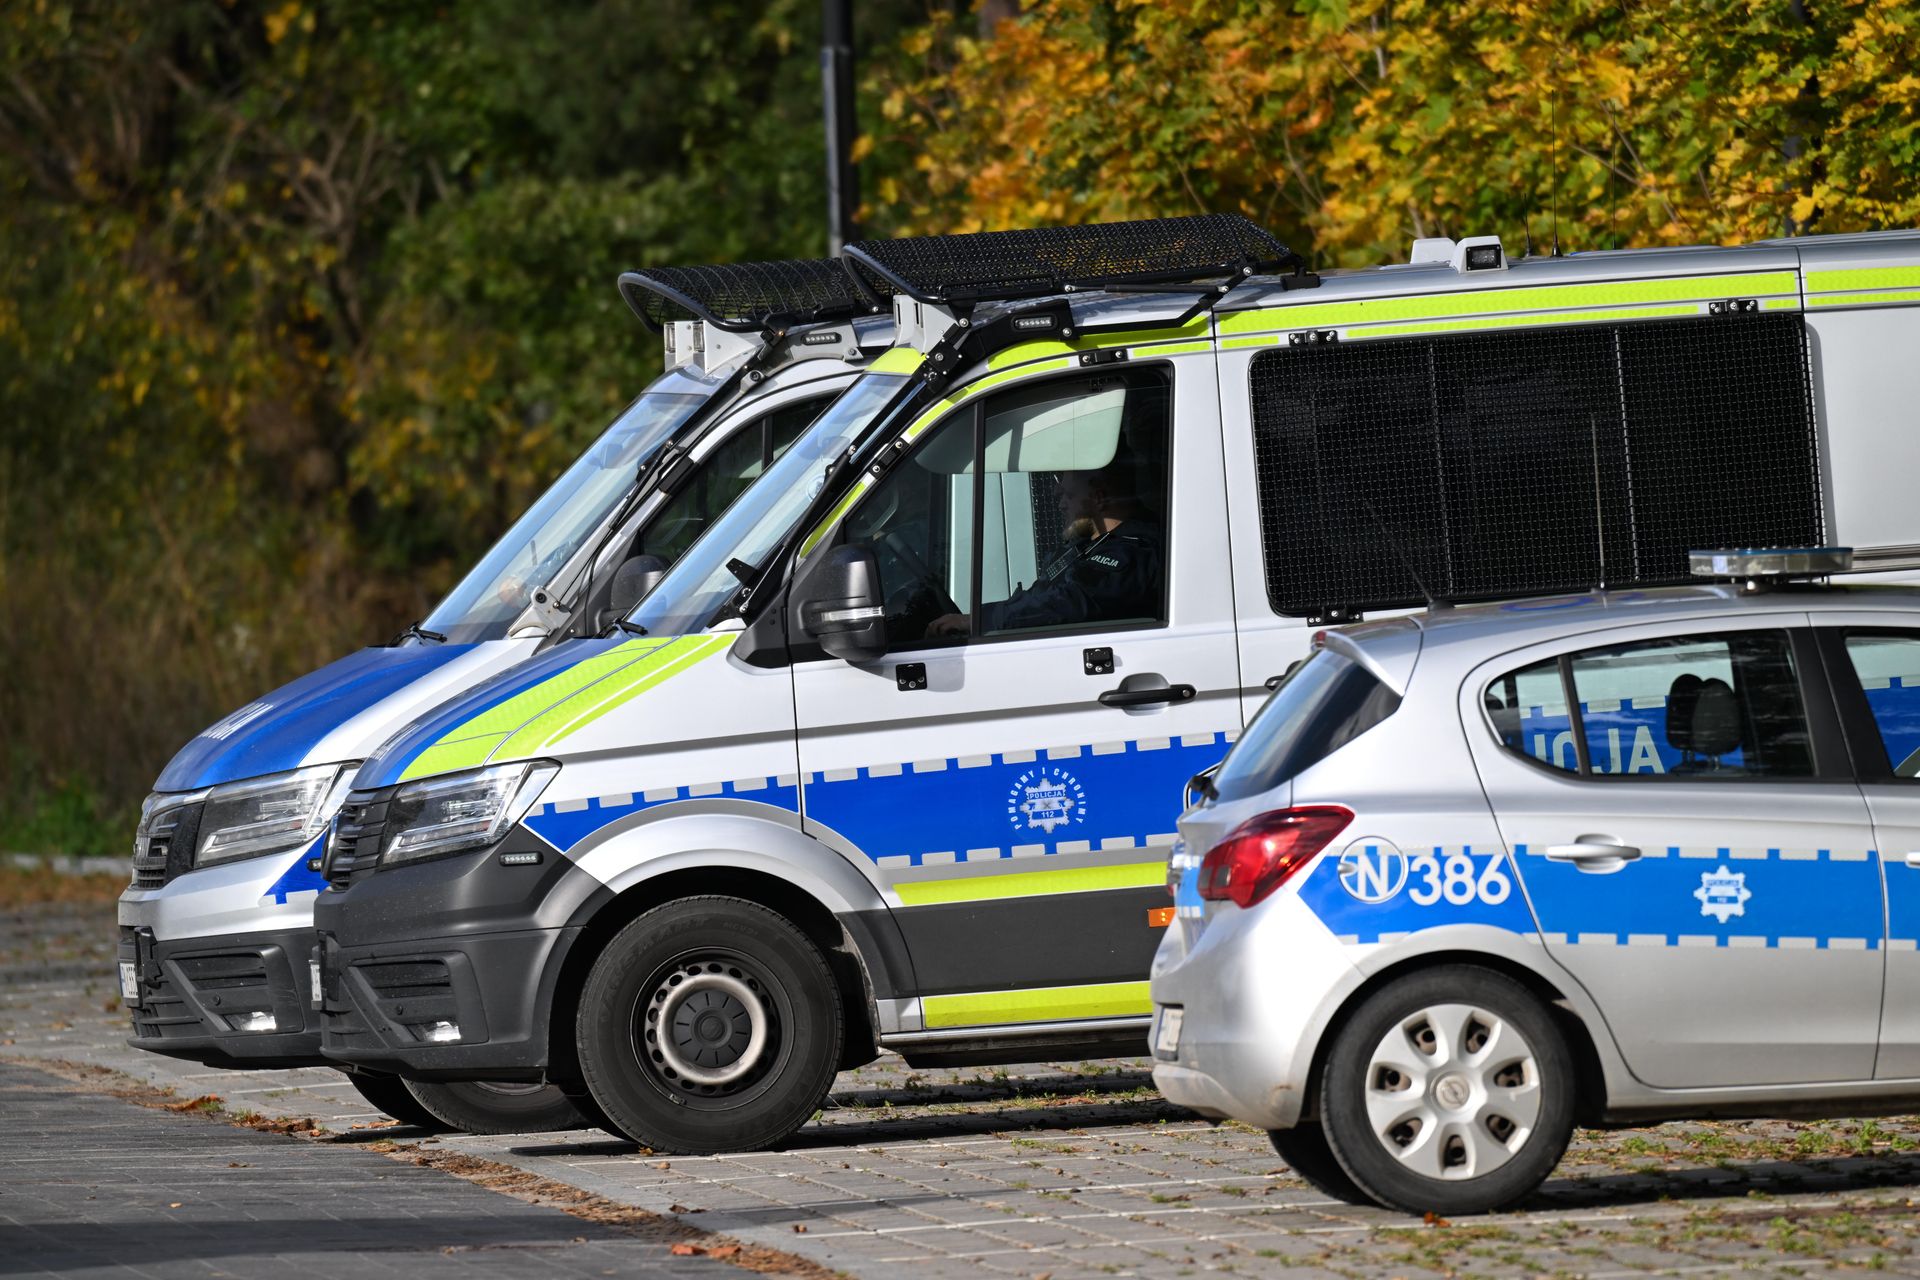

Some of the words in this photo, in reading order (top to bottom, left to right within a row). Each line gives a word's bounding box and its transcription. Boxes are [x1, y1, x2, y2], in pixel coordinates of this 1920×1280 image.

[1008, 770, 1035, 830] POMAGAMY
[1042, 767, 1046, 775] I
[1053, 768, 1087, 824] CHRONIMY
[1029, 790, 1063, 800] POLICJA
[1041, 810, 1055, 818] 112
[1408, 854, 1512, 906] 386
